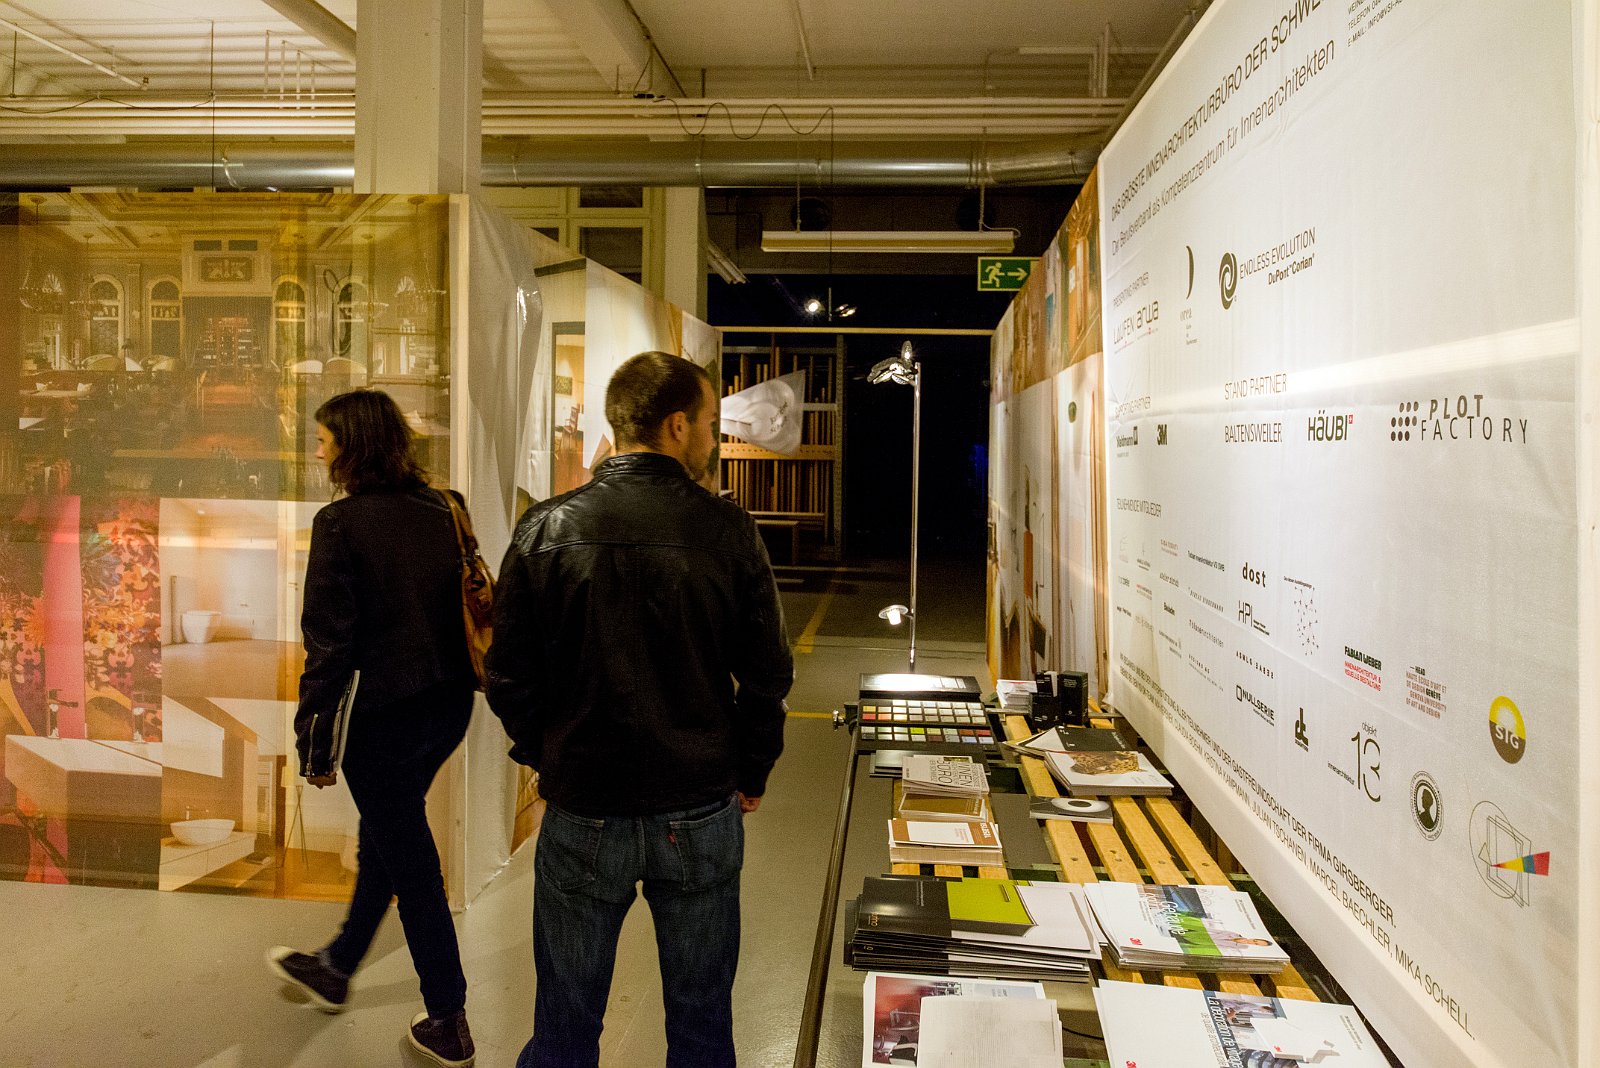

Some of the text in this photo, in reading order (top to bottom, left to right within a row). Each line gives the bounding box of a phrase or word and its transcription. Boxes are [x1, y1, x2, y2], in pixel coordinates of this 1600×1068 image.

[1348, 4, 1370, 30] TELEFON
[1121, 167, 1145, 210] GRÖSSTE
[1146, 65, 1242, 181] INNENARCHITEKTURBÜRO
[1245, 37, 1268, 80] DER
[1162, 140, 1225, 206] Kompetenzzentrum
[1227, 126, 1238, 152] für
[1241, 39, 1334, 139] Innenarchitekten
[1240, 227, 1316, 280] ENDLESS EVOLUTION
[1137, 300, 1159, 329] arwa
[1224, 373, 1287, 400] STAND PARTNER
[1157, 424, 1168, 445] 3M
[1224, 422, 1283, 443] BALTENSWEILER
[1421, 394, 1528, 444] PLOT FACTORY
[1242, 562, 1266, 588] dost
[1345, 646, 1382, 671] FABIAN WEBER
[1495, 724, 1520, 749] SIG
[1351, 731, 1381, 802] 13
[1211, 740, 1222, 757] UND
[1221, 748, 1232, 767] DER
[1232, 760, 1291, 826] GASTFREUNDSCHAFT
[1291, 816, 1308, 842] DER
[1308, 832, 1332, 868] FIRMA
[1333, 855, 1397, 929] GIRSBERGER.
[1161, 901, 1188, 935] Gebäude
[1252, 801, 1271, 830] JULIAN
[1272, 820, 1309, 868] TSCHANEN,
[1310, 858, 1341, 902] MARCEL
[1342, 890, 1393, 958] BAECHLER,
[1395, 945, 1422, 986] MIKA
[1425, 974, 1475, 1041] SCHELL.
[1129, 937, 1143, 946] 3M
[1207, 996, 1219, 1005] La
[1221, 1037, 1236, 1047] de
